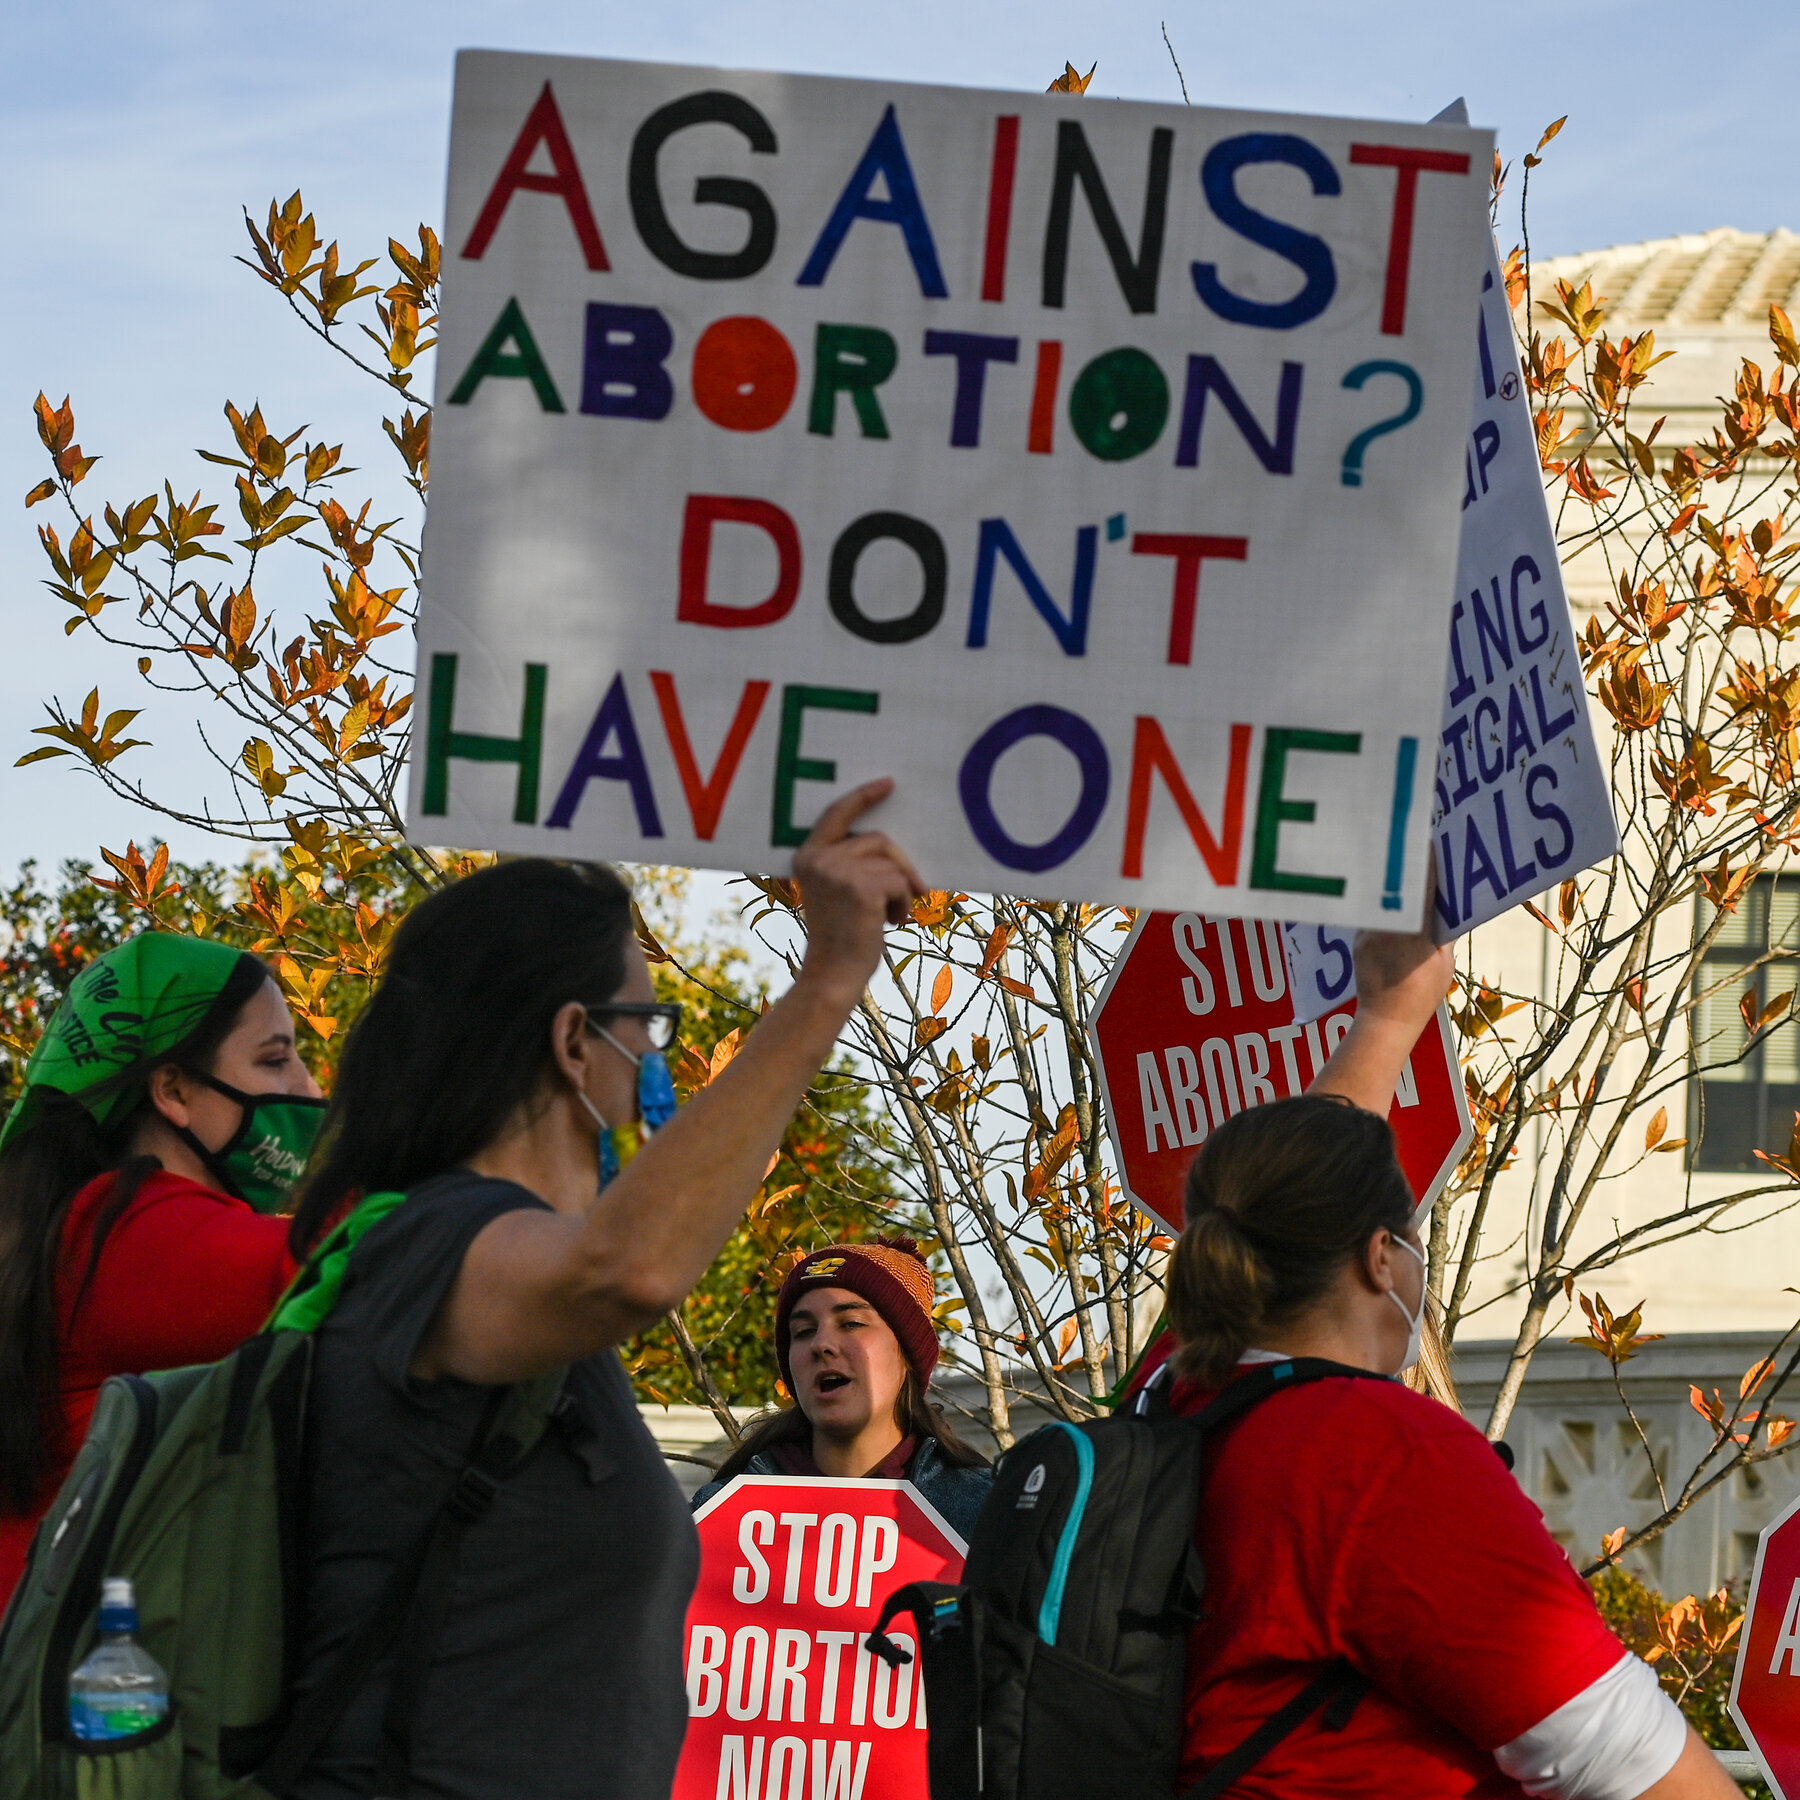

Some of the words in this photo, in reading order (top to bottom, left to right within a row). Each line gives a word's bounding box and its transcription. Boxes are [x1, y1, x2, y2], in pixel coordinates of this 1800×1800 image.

[459, 79, 1470, 334] AGAINST
[677, 493, 1248, 666] DON'T
[1450, 555, 1550, 707] ING
[420, 652, 879, 848] HAVE
[958, 703, 1418, 910] ONE!
[1171, 911, 1287, 1016] STO
[732, 1509, 900, 1608] STOP
[686, 1624, 928, 1730] BORTIO
[715, 1733, 873, 1800] NOW
